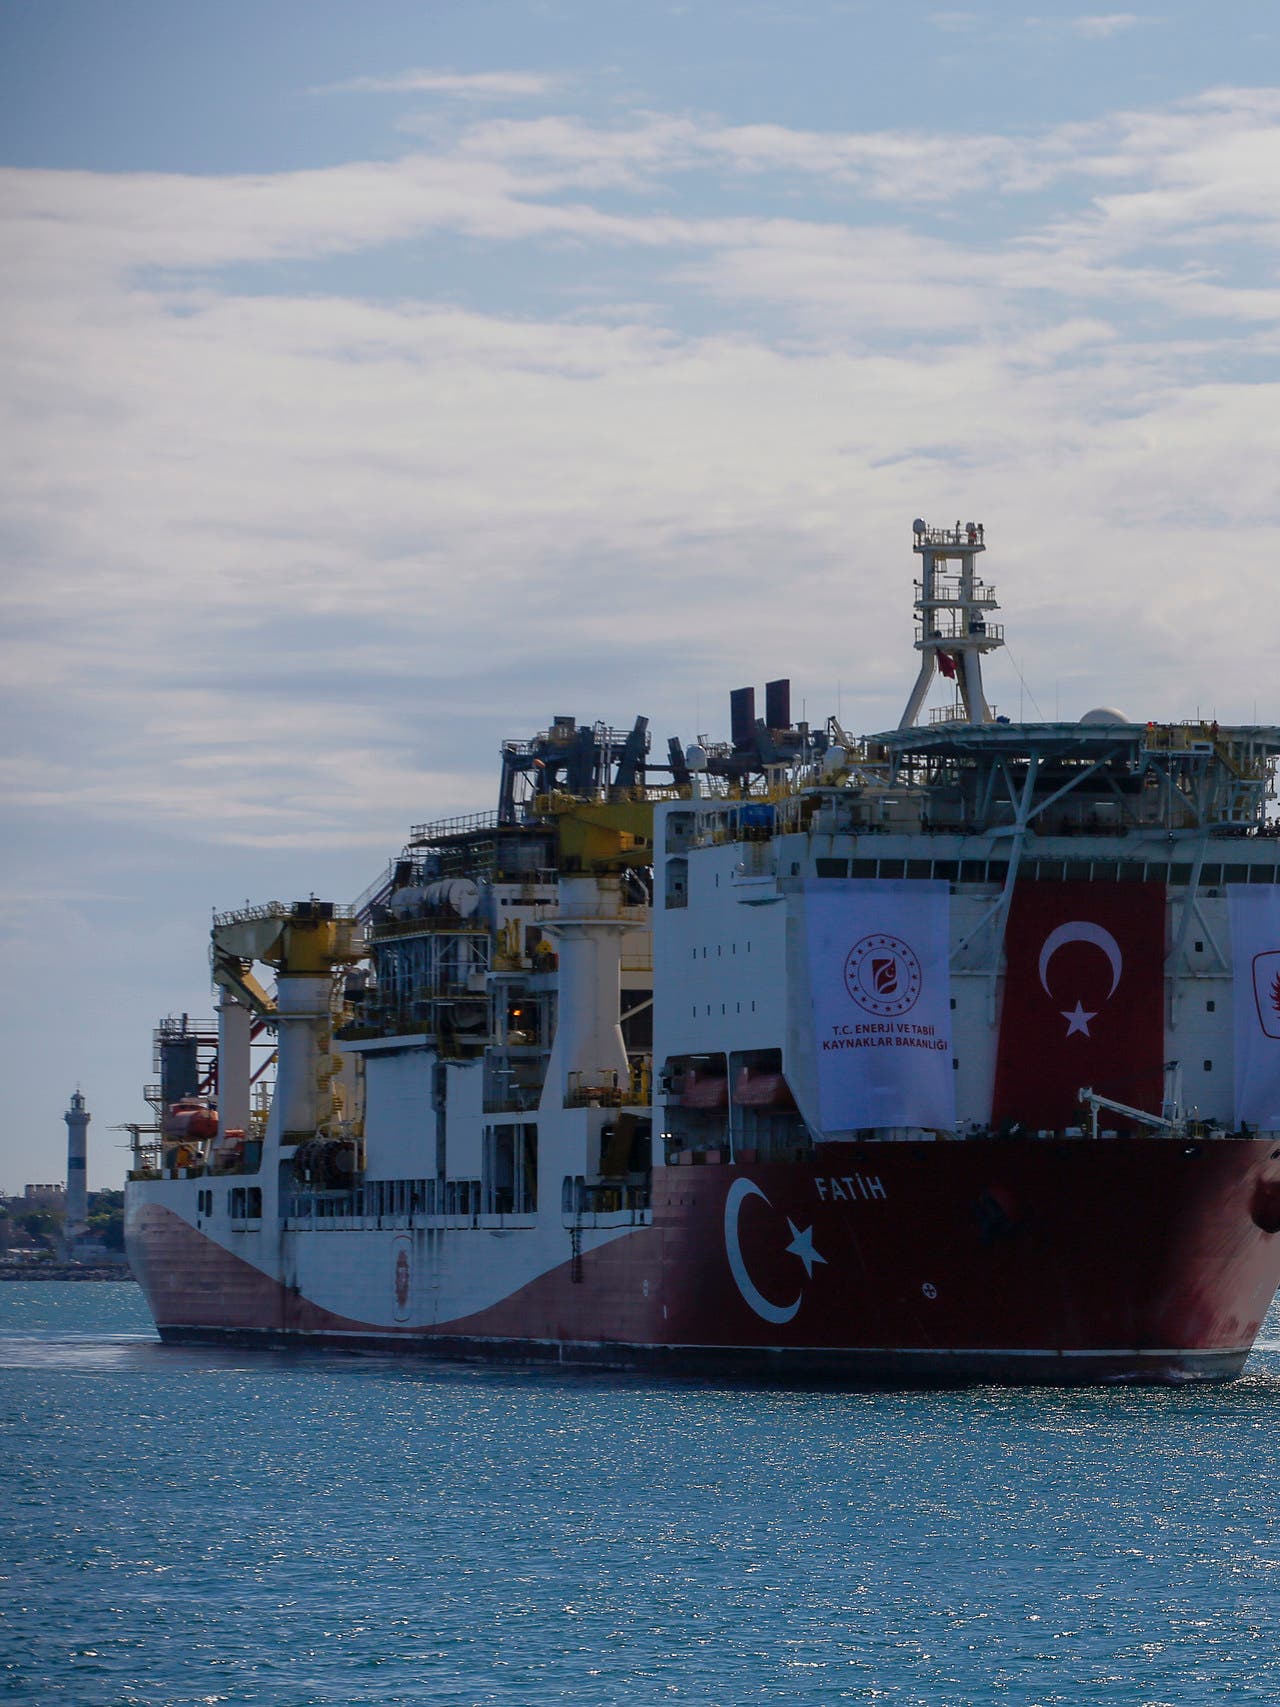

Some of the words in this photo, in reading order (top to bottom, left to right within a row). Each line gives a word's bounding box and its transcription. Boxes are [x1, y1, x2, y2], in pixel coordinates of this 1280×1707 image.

[832, 1026, 852, 1036] T.C.
[855, 1022, 894, 1035] ENERJİ
[896, 1023, 911, 1034] VE
[912, 1024, 935, 1036] TABİİ
[823, 1037, 893, 1051] KAYNAKLAR
[895, 1037, 948, 1051] BAKANLIĞI
[814, 1172, 887, 1200] FATİH
